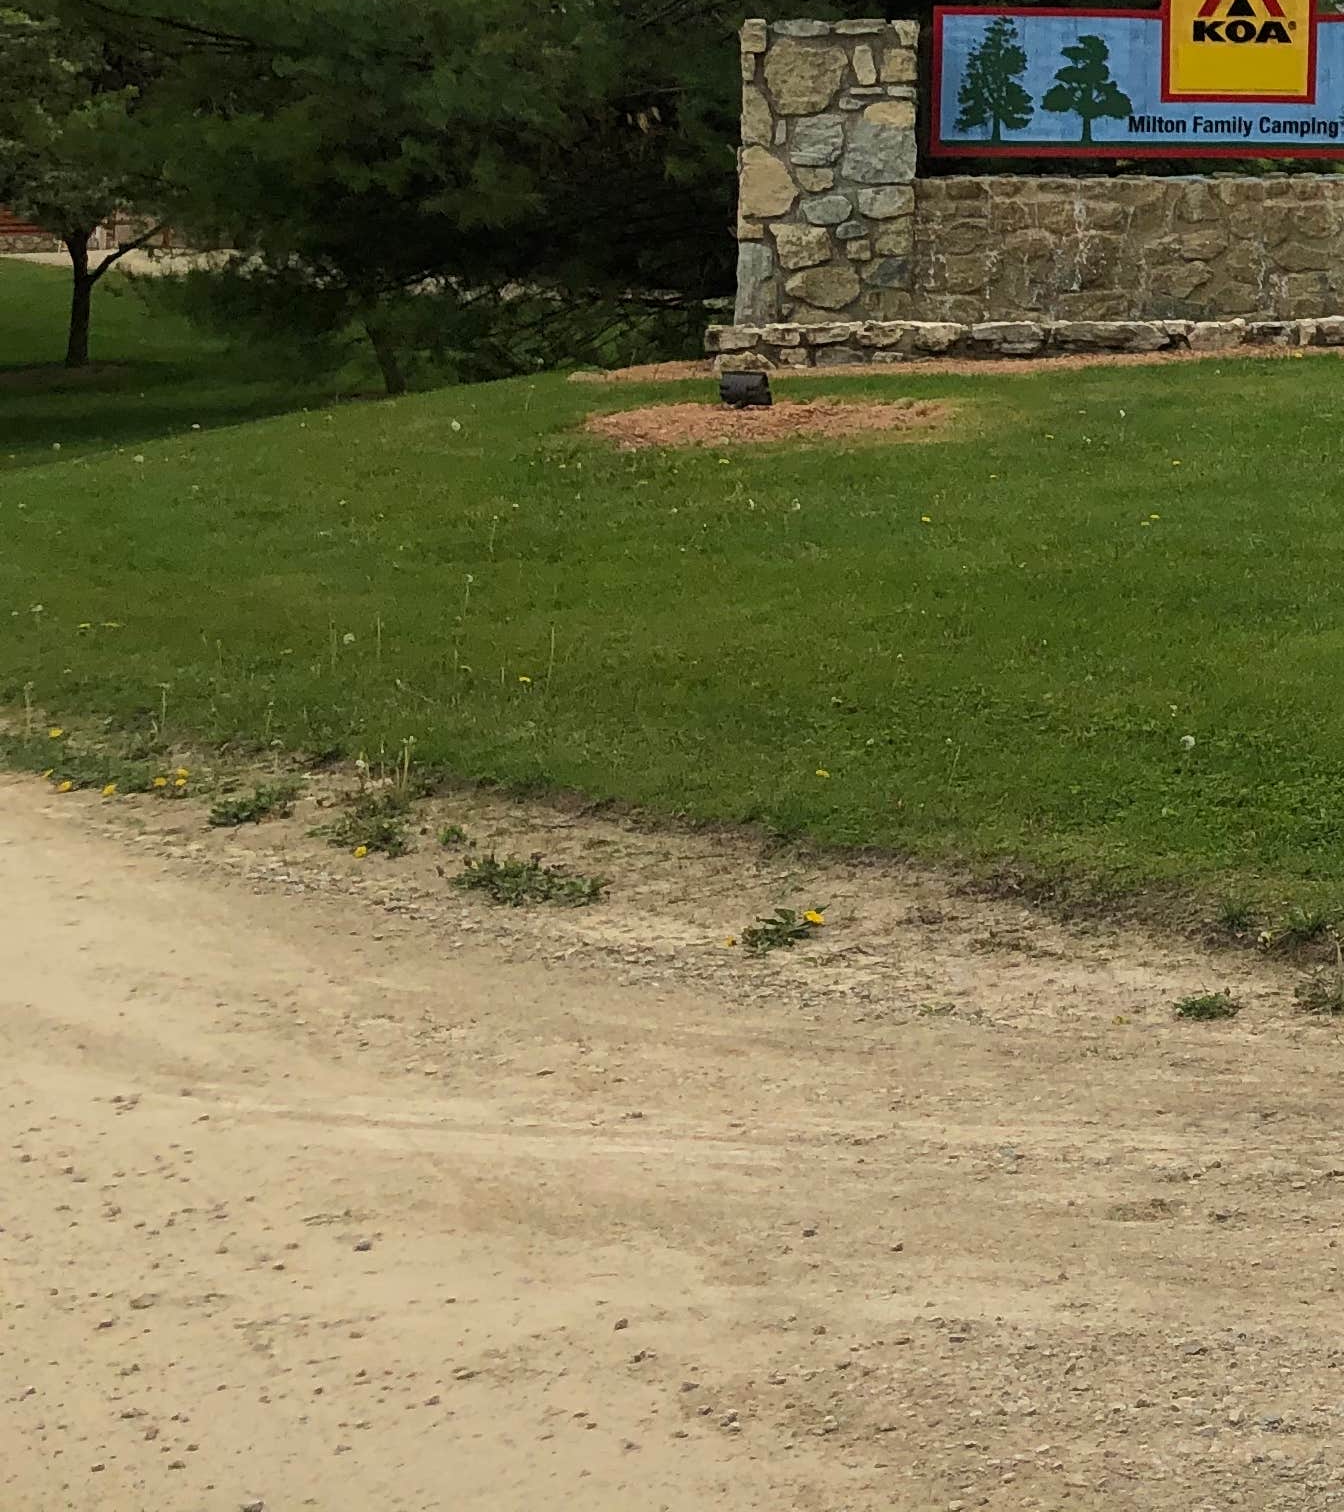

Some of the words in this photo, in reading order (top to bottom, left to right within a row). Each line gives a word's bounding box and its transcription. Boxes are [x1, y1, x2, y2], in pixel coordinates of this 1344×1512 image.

[1193, 20, 1292, 43] KOA
[1128, 115, 1187, 134] Milton
[1192, 116, 1253, 137] Family
[1259, 117, 1339, 138] Camping
